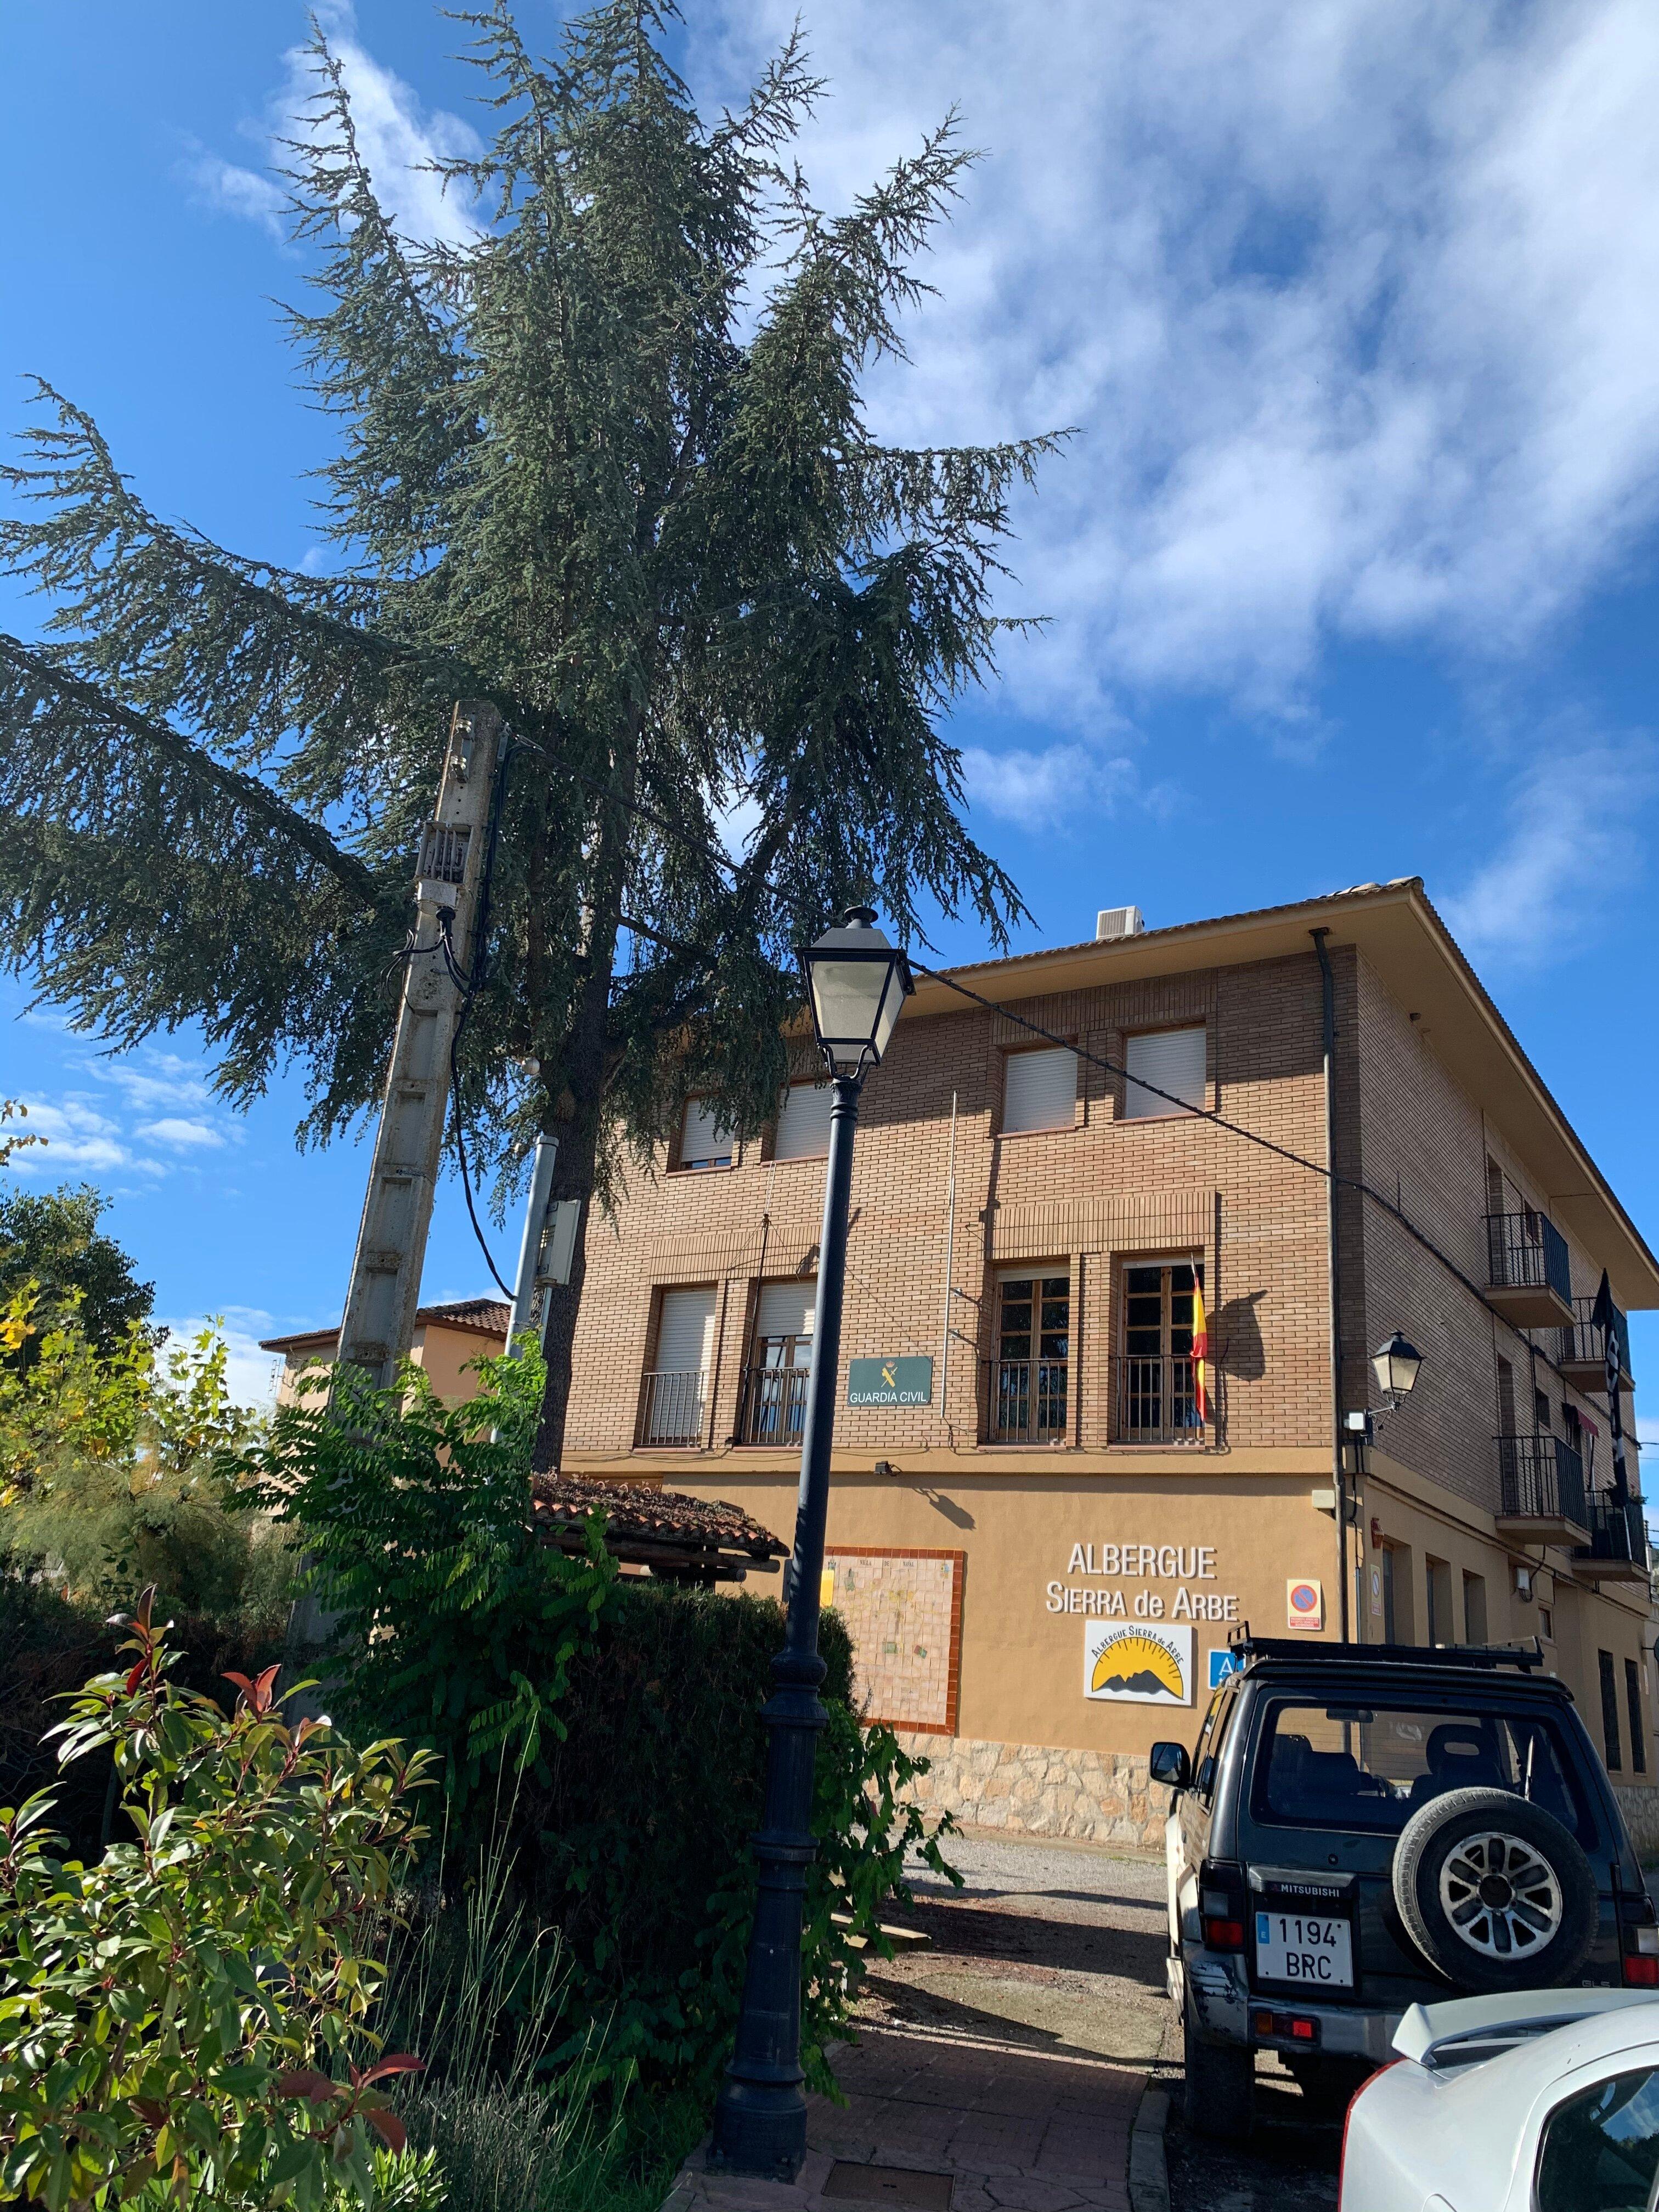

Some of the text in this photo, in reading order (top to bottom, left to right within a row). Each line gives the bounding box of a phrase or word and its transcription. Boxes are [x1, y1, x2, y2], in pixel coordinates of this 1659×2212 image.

[900, 1391, 927, 1402] CIVIL
[1068, 1543, 1215, 1579] ALBERGUE
[1046, 1581, 1238, 1622] SIERRA de ARBE
[1091, 1629, 1127, 1658] ALBERGUE
[1158, 1637, 1166, 1646] de
[1166, 1641, 1184, 1664] ARBE
[1218, 1657, 1233, 1676] A
[1281, 1884, 1340, 1897] MITSUBISHI
[1279, 1918, 1337, 1947] 1194
[1286, 1952, 1331, 1979] BRC
[1582, 1980, 1611, 1988] GLS
